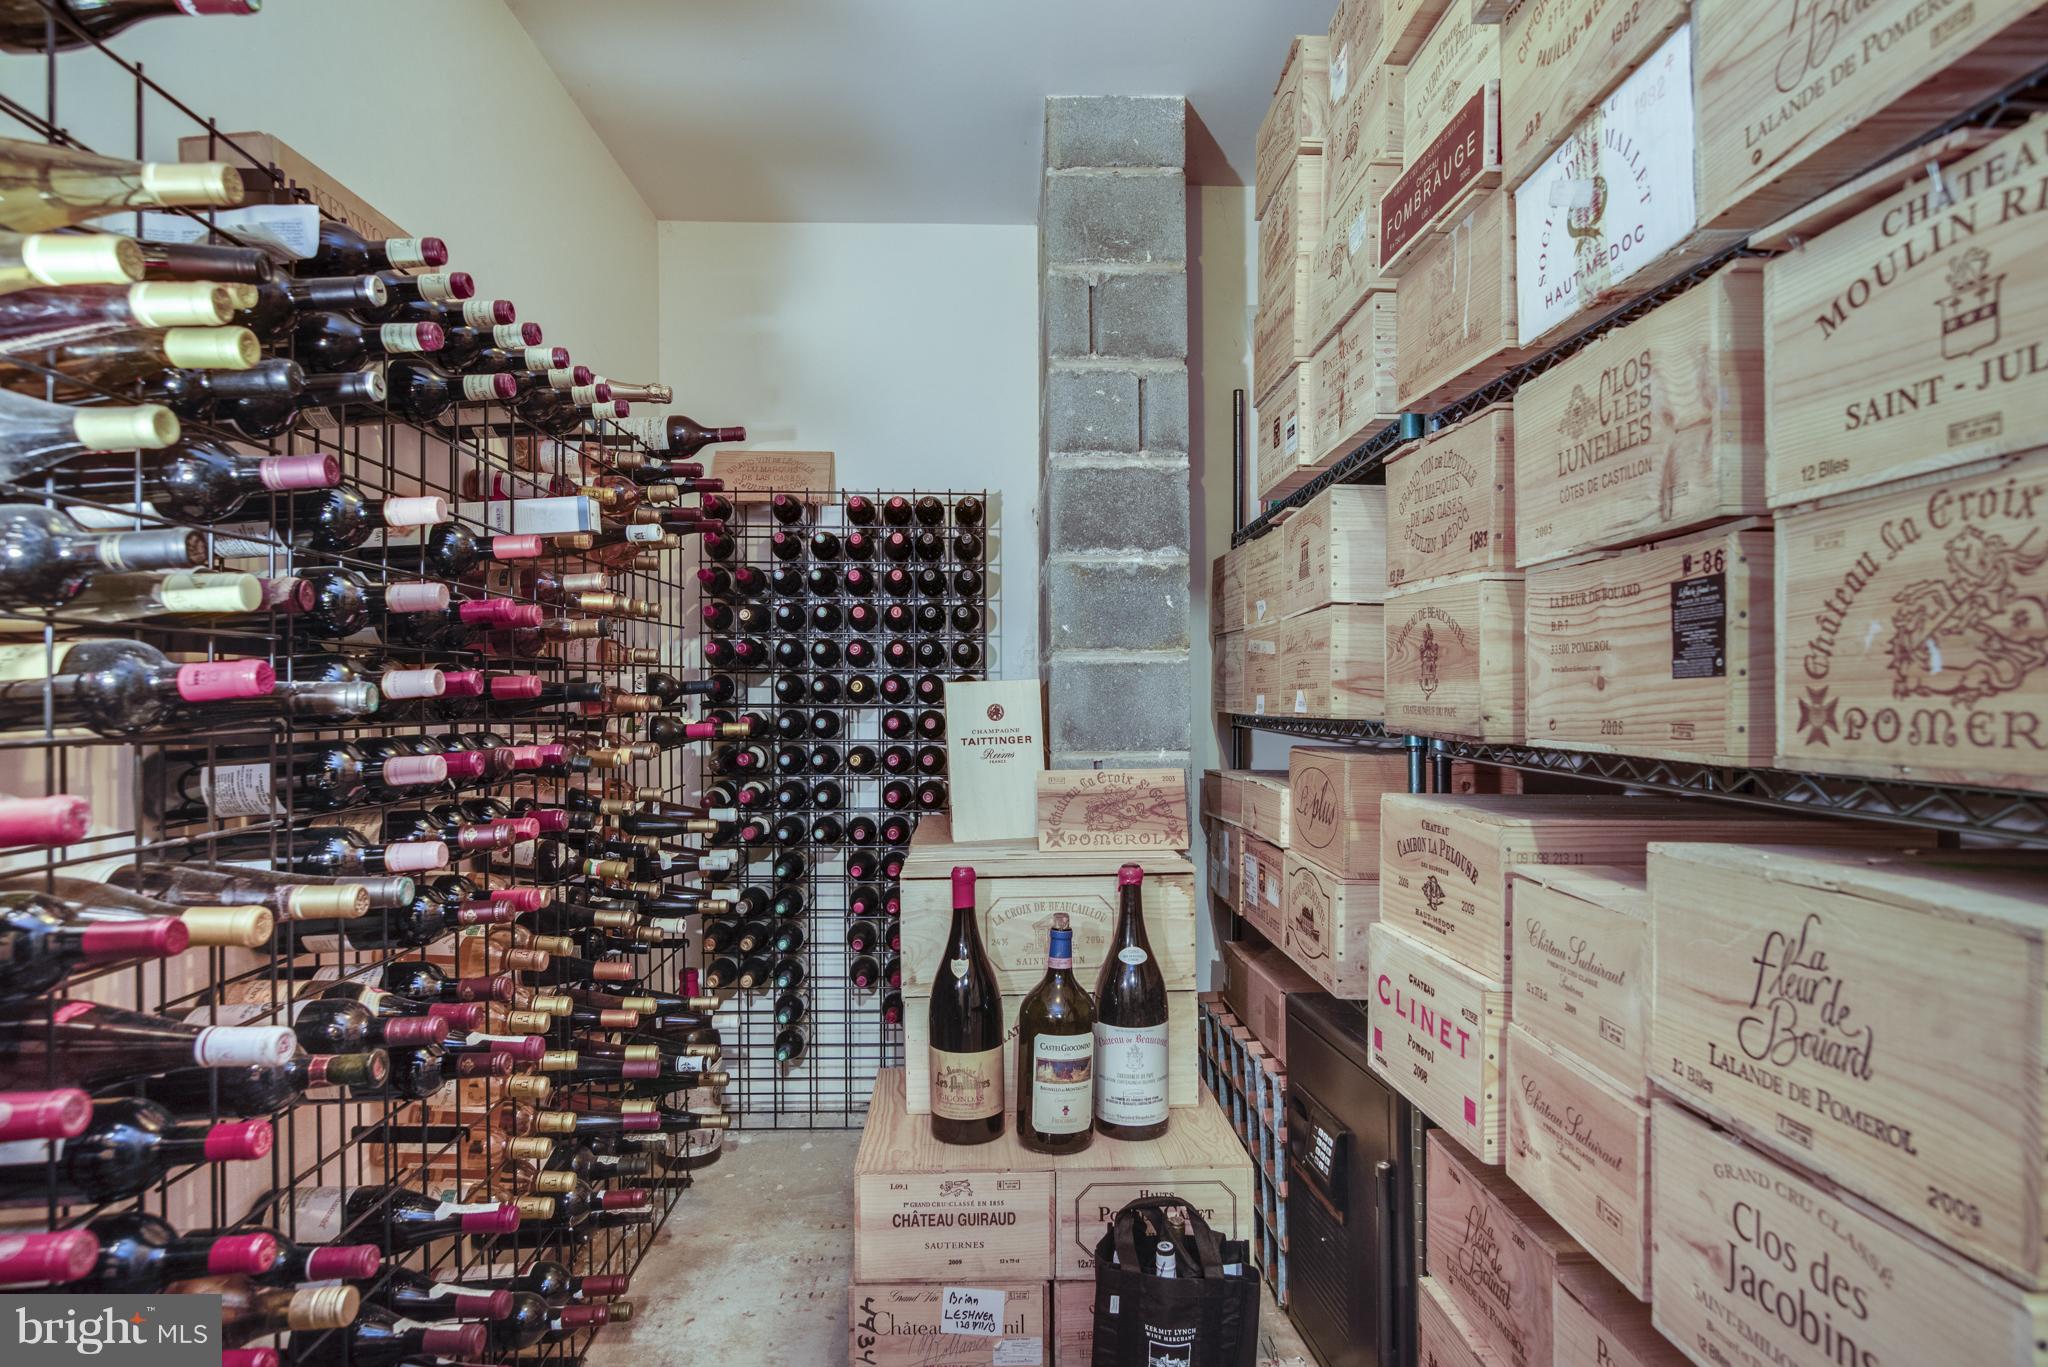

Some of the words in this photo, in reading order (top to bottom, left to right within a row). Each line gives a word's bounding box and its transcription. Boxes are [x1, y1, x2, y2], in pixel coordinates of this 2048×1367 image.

[1611, 1, 1641, 46] 1982
[1744, 77, 1827, 149] LALANDE
[1830, 58, 1859, 88] DE
[1386, 130, 1477, 241] FOMBRAUGE
[1815, 203, 1978, 341] MOULIN
[1557, 414, 1653, 478] LUNELLES
[1420, 455, 1434, 477] VIN
[1587, 477, 1599, 495] DE
[1601, 456, 1653, 490] CASTILLON
[1801, 466, 1817, 482] 12
[1410, 512, 1421, 528] DE
[1421, 505, 1435, 525] LAS
[1436, 496, 1464, 520] CASES
[1803, 550, 1882, 681] Château
[1880, 517, 1922, 561] La
[1927, 477, 2046, 530] Croix
[1561, 592, 1588, 608] FLEUR
[1588, 589, 1601, 603] DE
[1571, 640, 1612, 655] POMEROL
[960, 734, 1033, 747] TAITTINGER
[971, 727, 1021, 735] CHAMPAGNE
[980, 748, 1016, 762] Reims
[1096, 771, 1135, 786] Croix
[1066, 833, 1164, 846] POMEROL
[1397, 836, 1427, 858] CAMBON
[1428, 838, 1438, 856] LA
[1439, 839, 1479, 886] PELOUSE
[991, 914, 1006, 927] LA
[1004, 903, 1033, 919] CROIX
[1034, 901, 1047, 912] DE
[1049, 900, 1109, 924] BEAUCAILLOU
[1791, 912, 1829, 973] La
[1408, 973, 1436, 998] CHATEAU
[1749, 930, 1832, 1010] fleur
[1820, 979, 1861, 1037] de
[1377, 974, 1471, 1060] CLINET
[1407, 1032, 1435, 1064] Pomerol
[1708, 1042, 1783, 1096] LALANDE
[1788, 1082, 1812, 1108] DE
[1816, 1086, 1918, 1157] POMEROL
[1712, 1162, 1772, 1193] GRAND
[1774, 1177, 1813, 1215] CRU
[892, 1211, 954, 1228] CHÂTEAU
[957, 1211, 1017, 1228] GUIRAUD
[924, 1241, 985, 1250] SAUTERNES
[1731, 1200, 1798, 1275] Clos
[1809, 1251, 1870, 1323] des
[949, 1292, 979, 1306] Brian
[944, 1309, 994, 1322] LESHNER
[1144, 1323, 1173, 1336] KERMIT
[1173, 1326, 1197, 1336] LYNCH
[1145, 1331, 1164, 1340] WINE
[1164, 1333, 1196, 1342] MERCHANT
